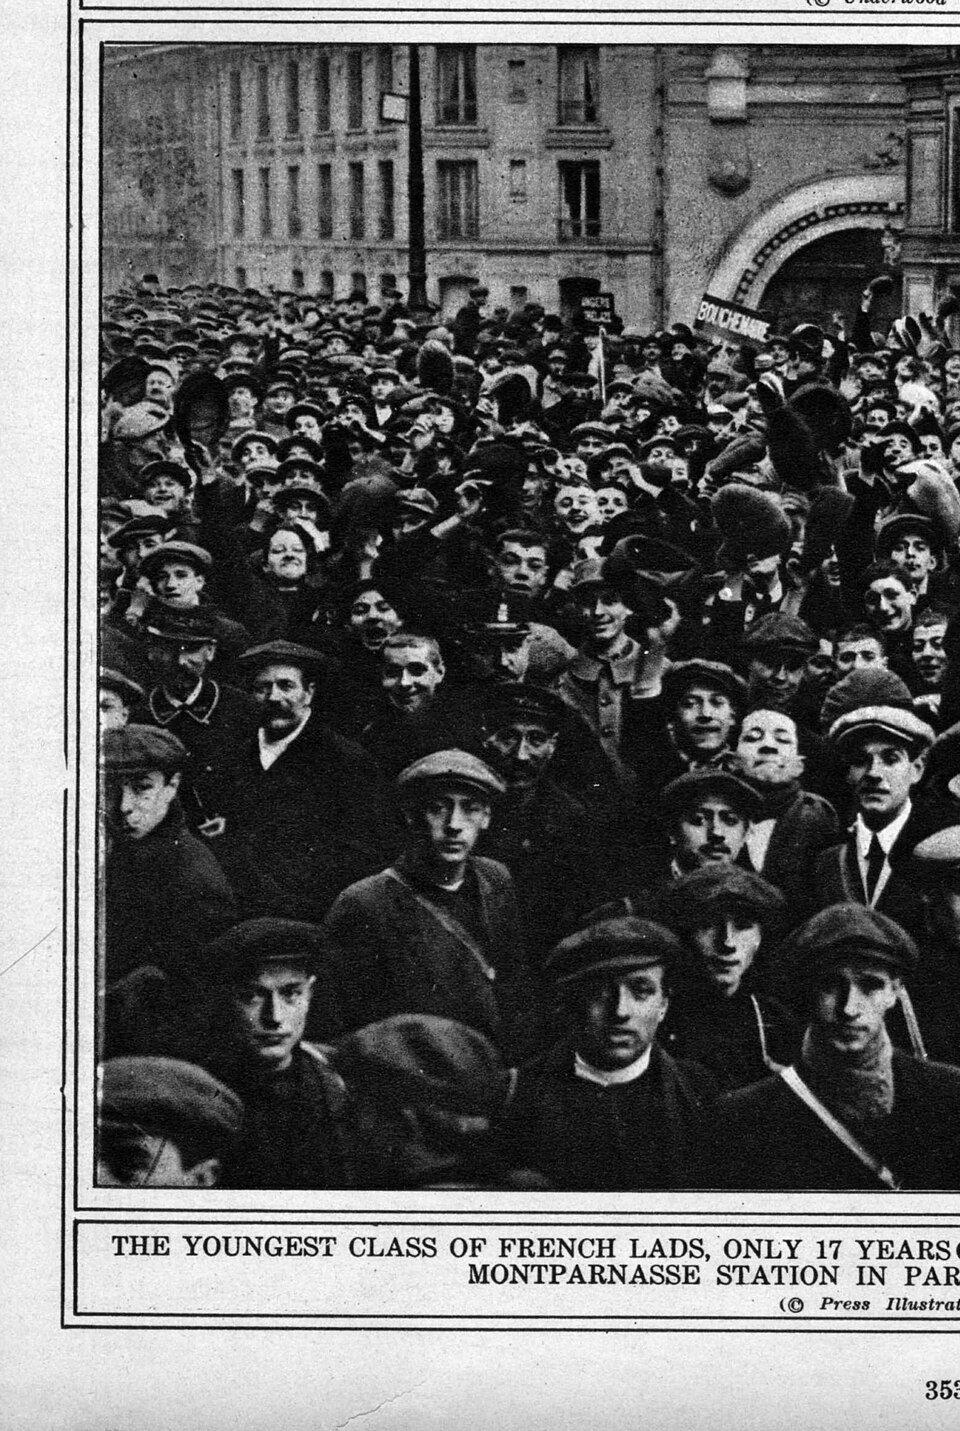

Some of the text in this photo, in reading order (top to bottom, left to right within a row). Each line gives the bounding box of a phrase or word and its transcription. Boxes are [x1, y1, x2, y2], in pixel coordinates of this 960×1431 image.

[111, 1235, 170, 1257] THE
[181, 1235, 337, 1258] YOUNGEST
[348, 1236, 438, 1258] CLASS
[449, 1237, 487, 1259] OF
[498, 1237, 617, 1259] FRENCH
[628, 1237, 711, 1263] LADS,
[723, 1238, 803, 1260] ONLY
[816, 1239, 843, 1261] 17
[854, 1239, 952, 1261] YEARS
[468, 1263, 701, 1286] MONTPARNASSE
[716, 1264, 840, 1286] STATION
[855, 1265, 888, 1287] IN
[819, 1296, 871, 1311] Press
